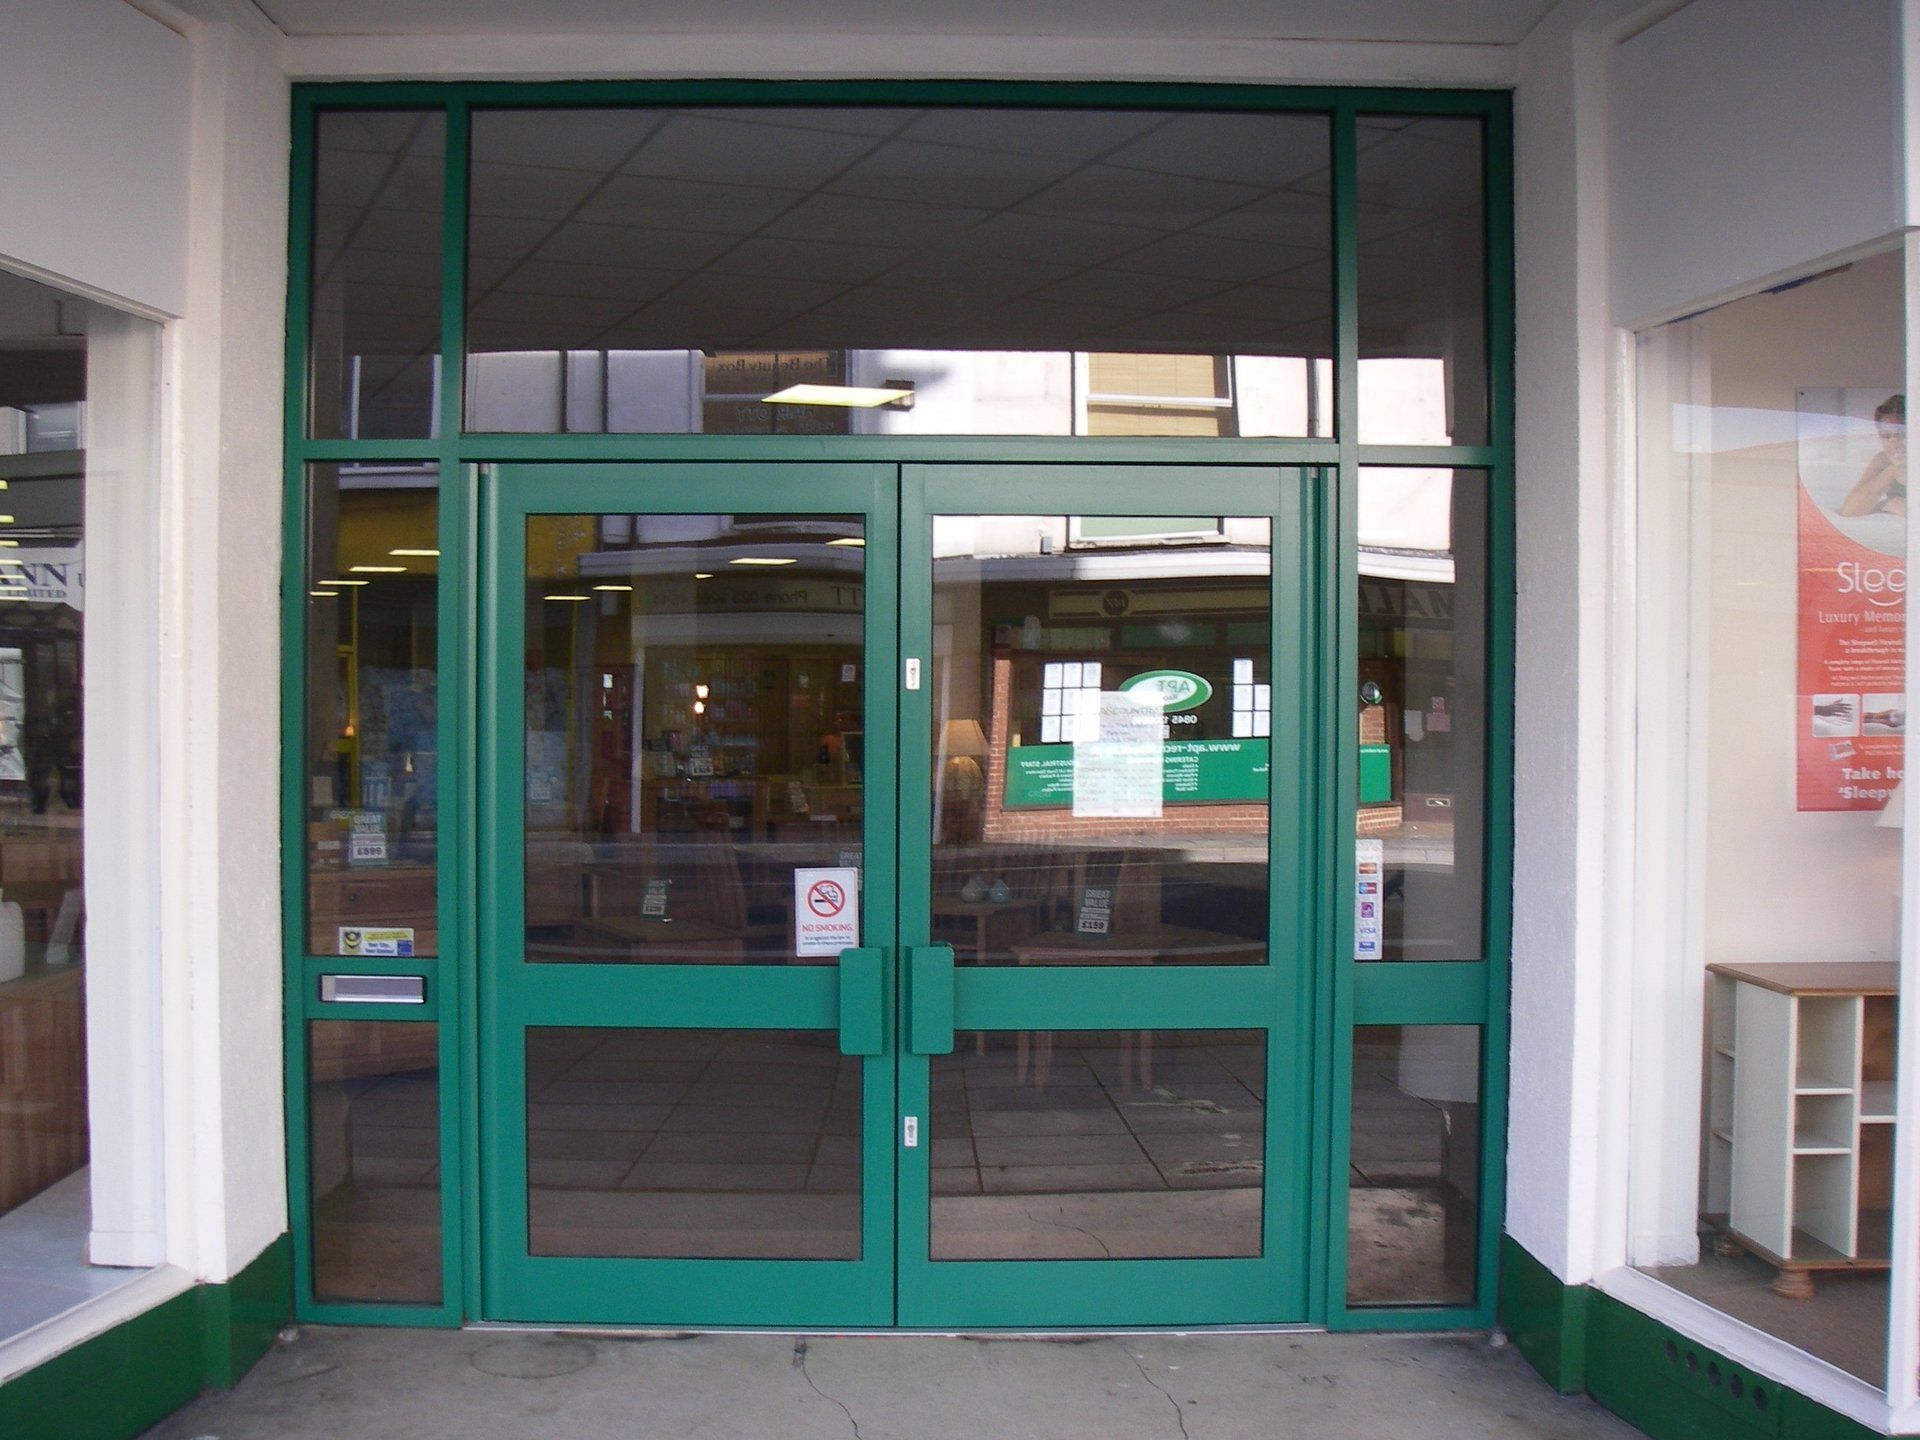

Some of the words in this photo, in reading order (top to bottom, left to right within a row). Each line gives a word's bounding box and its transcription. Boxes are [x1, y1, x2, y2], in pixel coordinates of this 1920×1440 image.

[1819, 610, 1860, 626] Luxury
[1842, 767, 1881, 780] Take
[802, 923, 814, 932] NO
